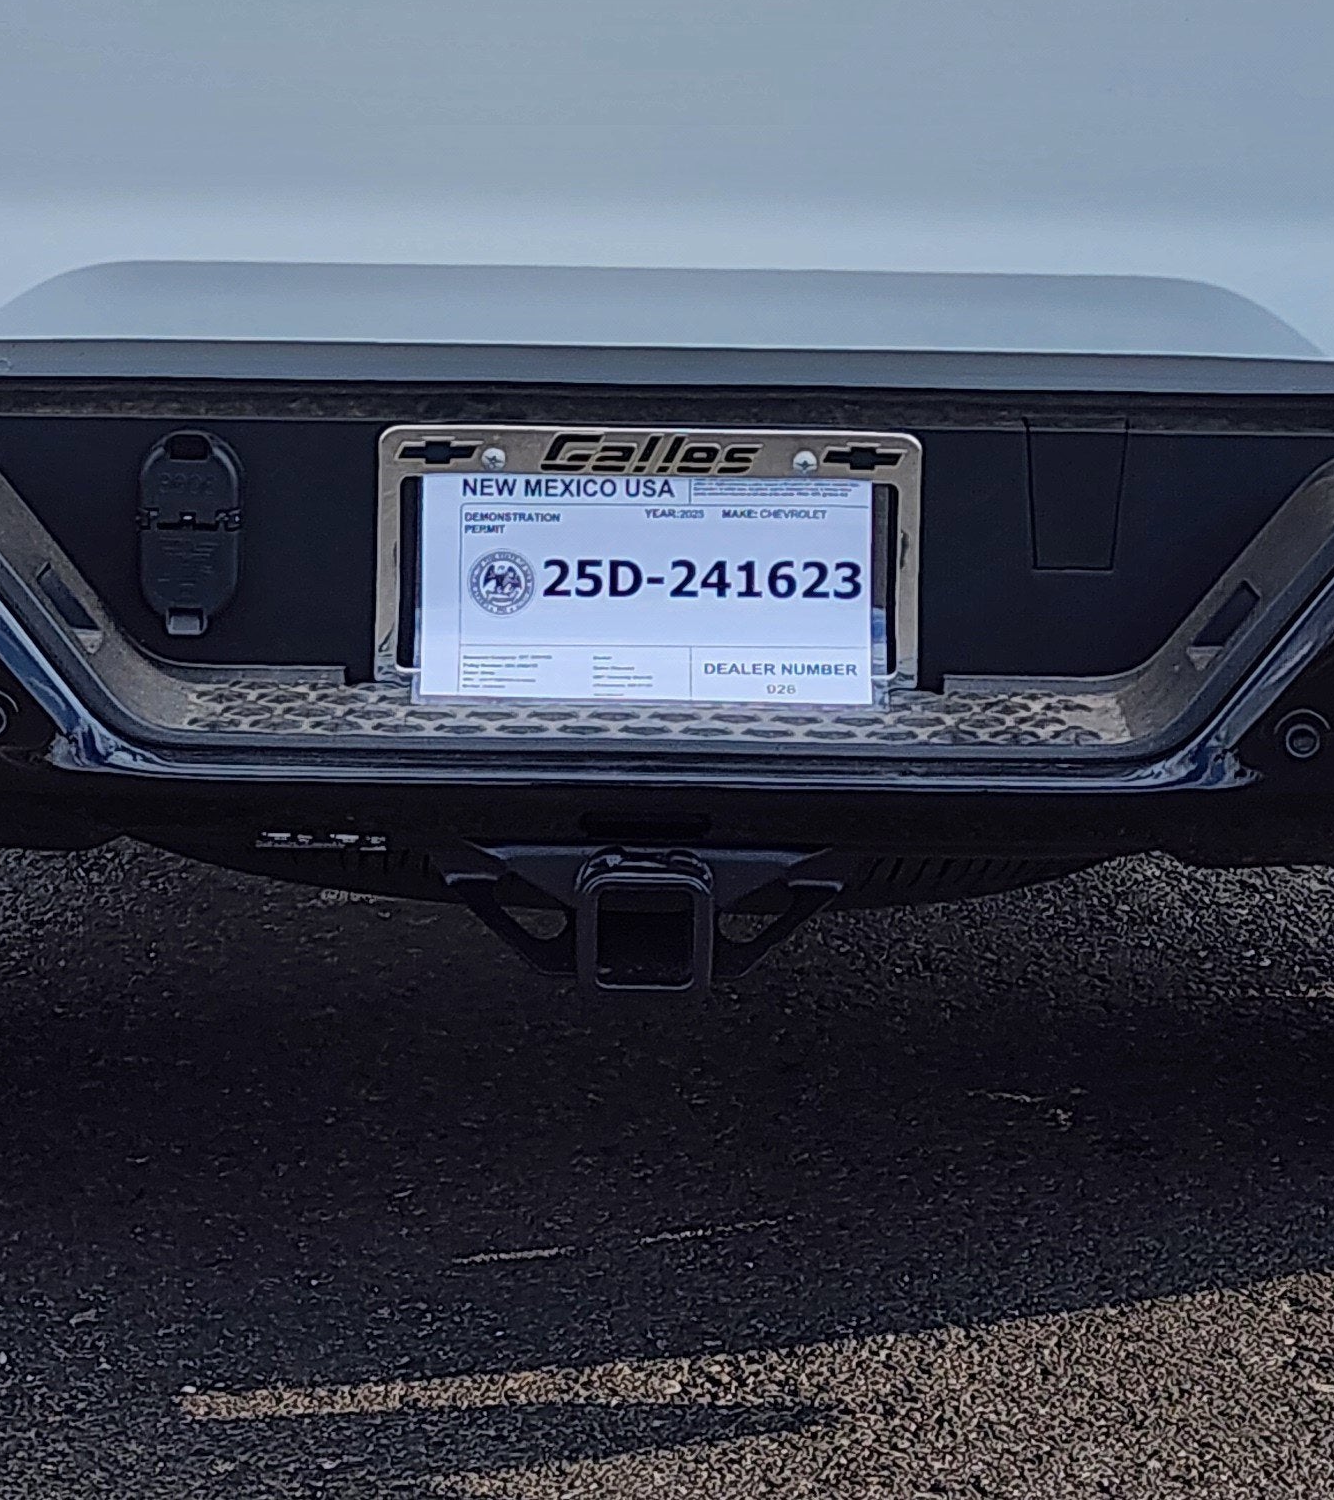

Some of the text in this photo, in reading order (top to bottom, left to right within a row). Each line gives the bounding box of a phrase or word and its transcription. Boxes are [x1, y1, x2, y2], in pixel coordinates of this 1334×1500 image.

[540, 431, 765, 474] Galles
[462, 478, 516, 497] NEW
[524, 478, 616, 498] MEXICO
[625, 479, 675, 498] USA
[464, 512, 561, 522] DEMONSTRATION
[722, 509, 758, 519] MAKE:
[760, 509, 827, 519] CHEVROLET
[464, 524, 505, 534] PERMIT
[542, 559, 863, 599] 25D-241623
[704, 662, 857, 677] DEALER NUMBER
